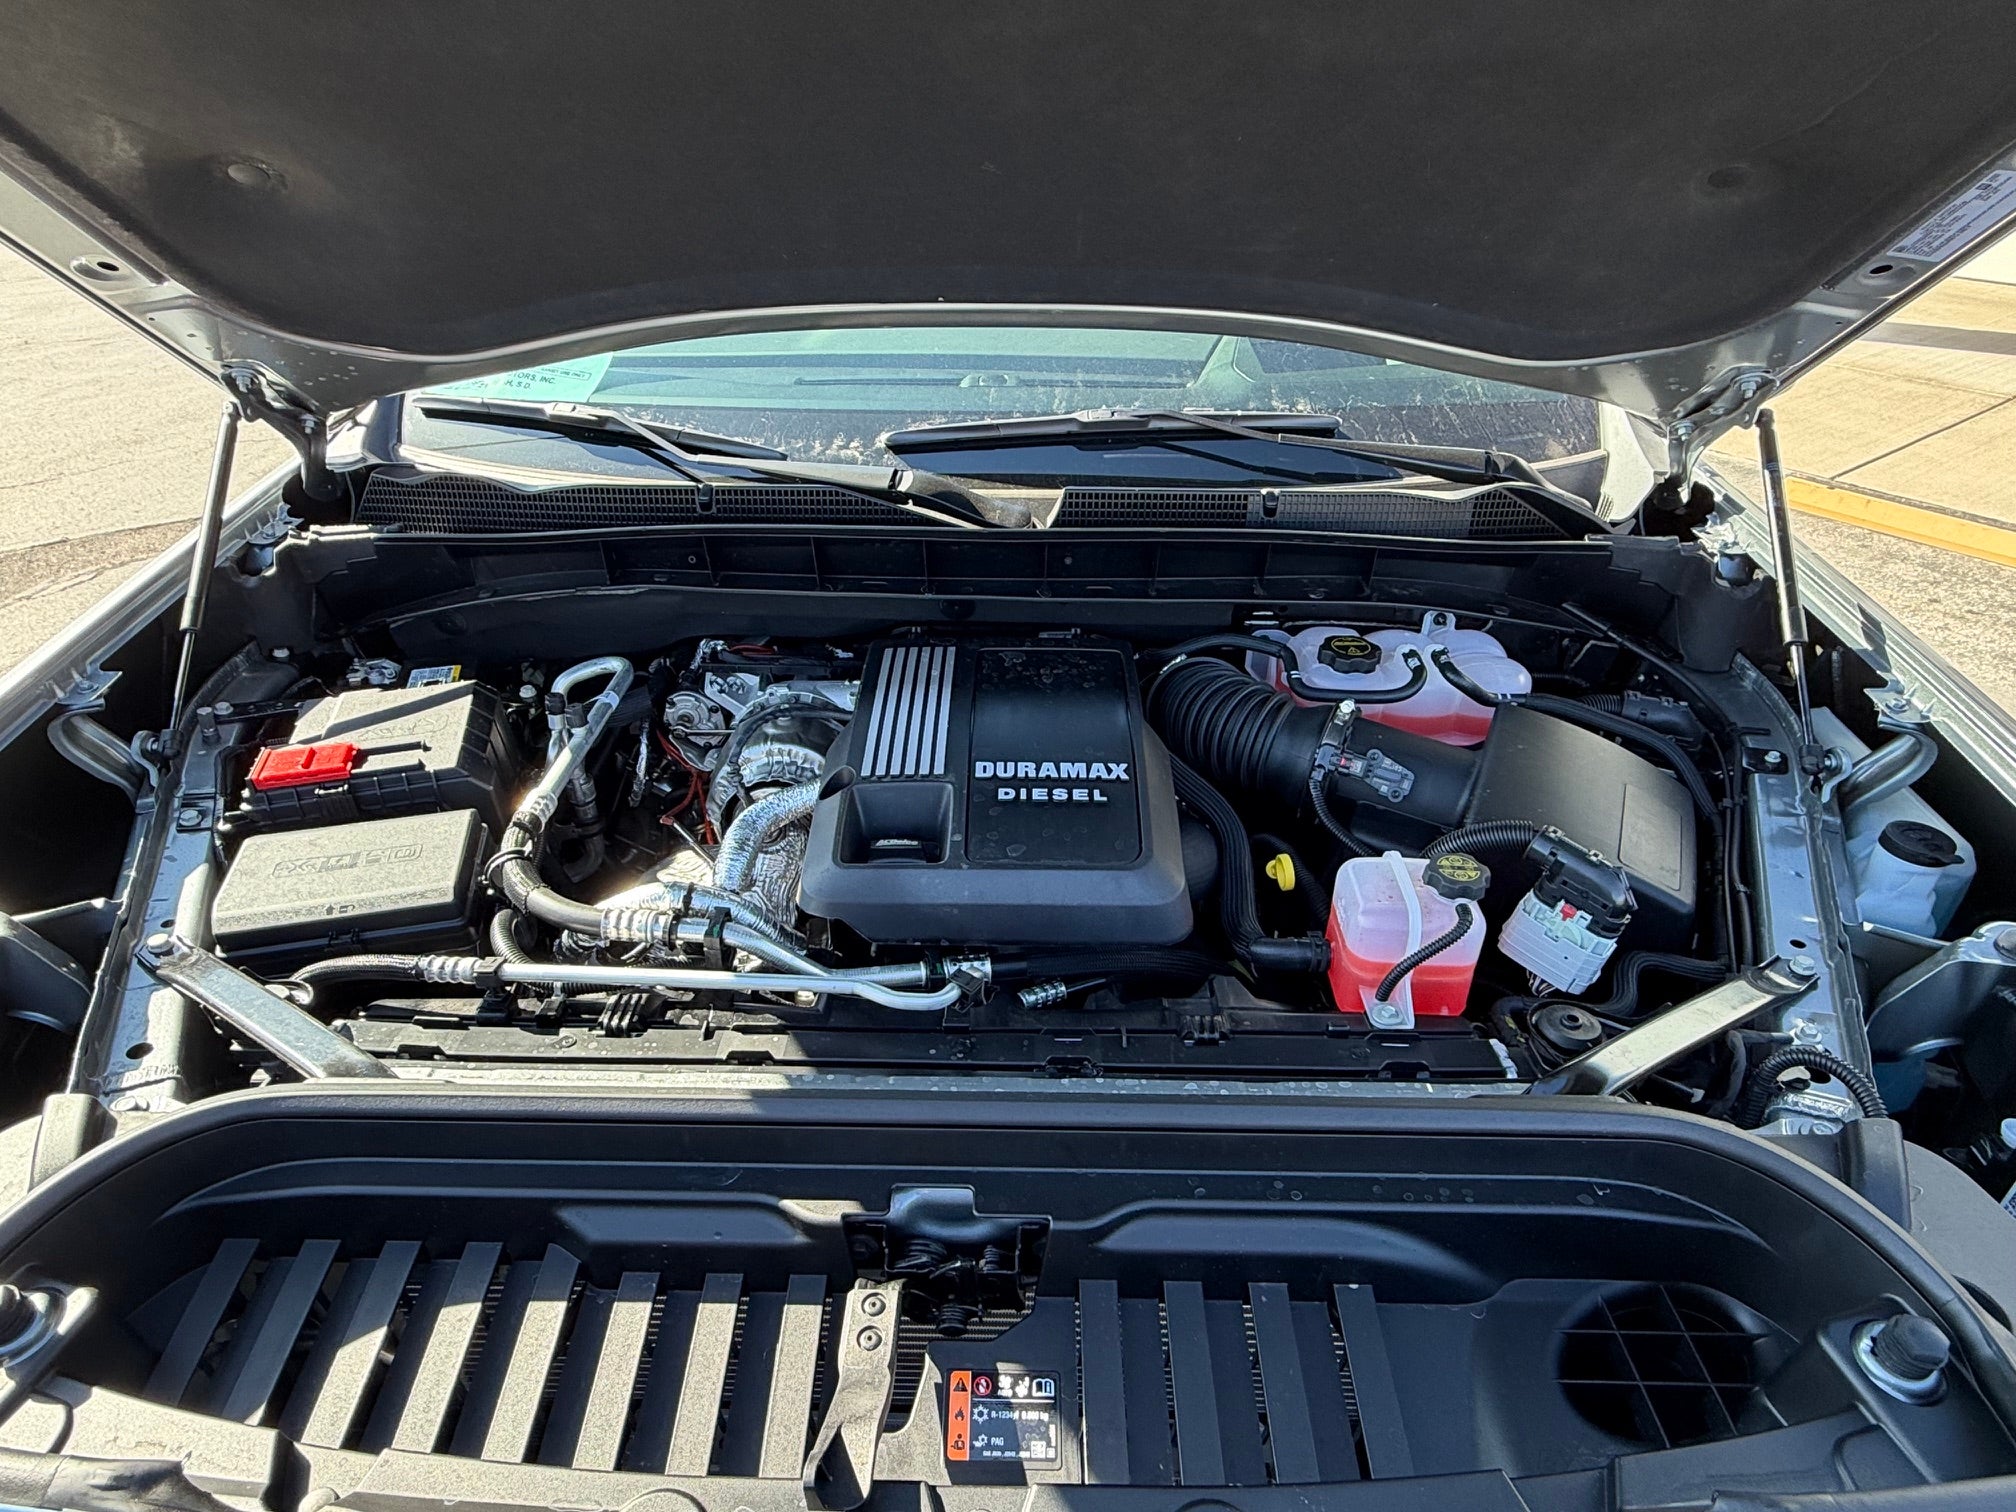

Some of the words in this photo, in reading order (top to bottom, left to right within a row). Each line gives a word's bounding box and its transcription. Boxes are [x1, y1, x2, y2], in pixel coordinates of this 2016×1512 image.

[975, 761, 1129, 780] DURAMAX
[998, 788, 1108, 802] DIESEL
[990, 1437, 1004, 1446] PAG
